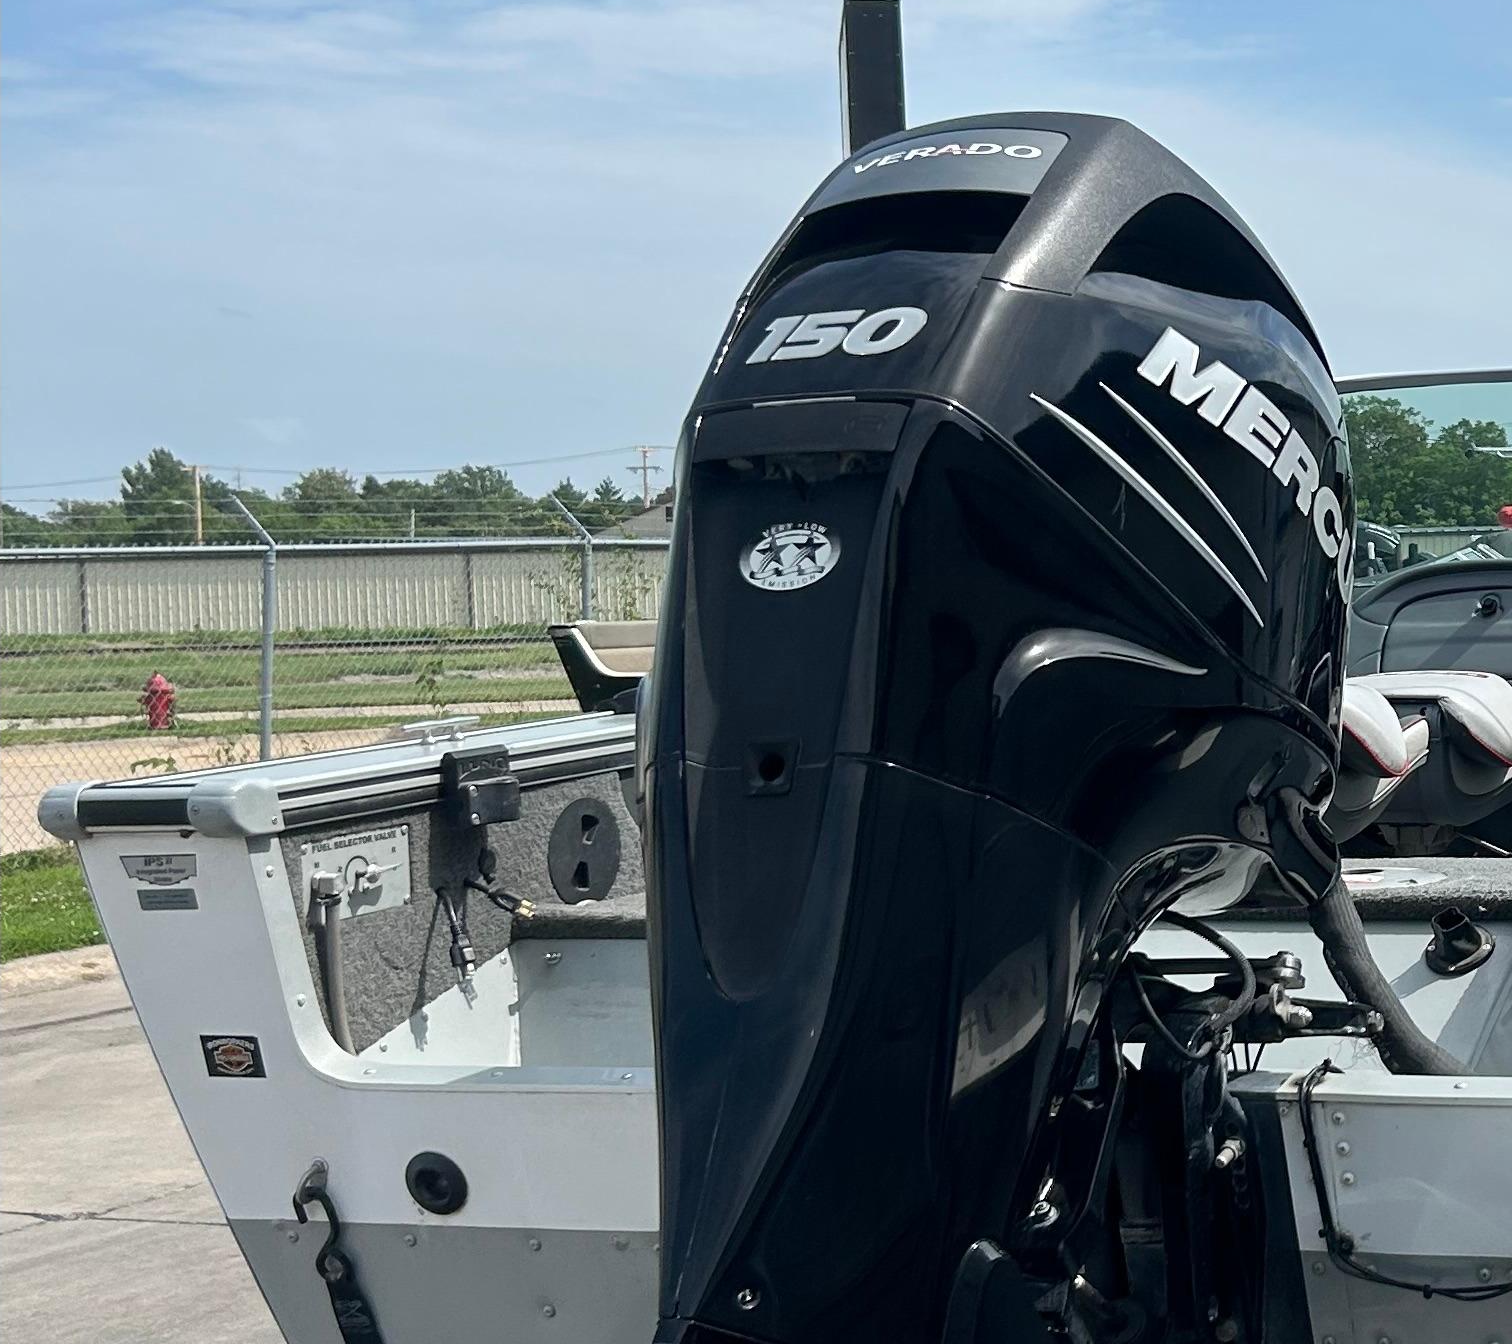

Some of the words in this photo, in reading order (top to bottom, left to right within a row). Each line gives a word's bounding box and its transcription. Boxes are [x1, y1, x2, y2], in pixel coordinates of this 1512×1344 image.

[854, 142, 1043, 174] VERADO
[745, 306, 929, 365] 150
[311, 842, 332, 853] FUEL
